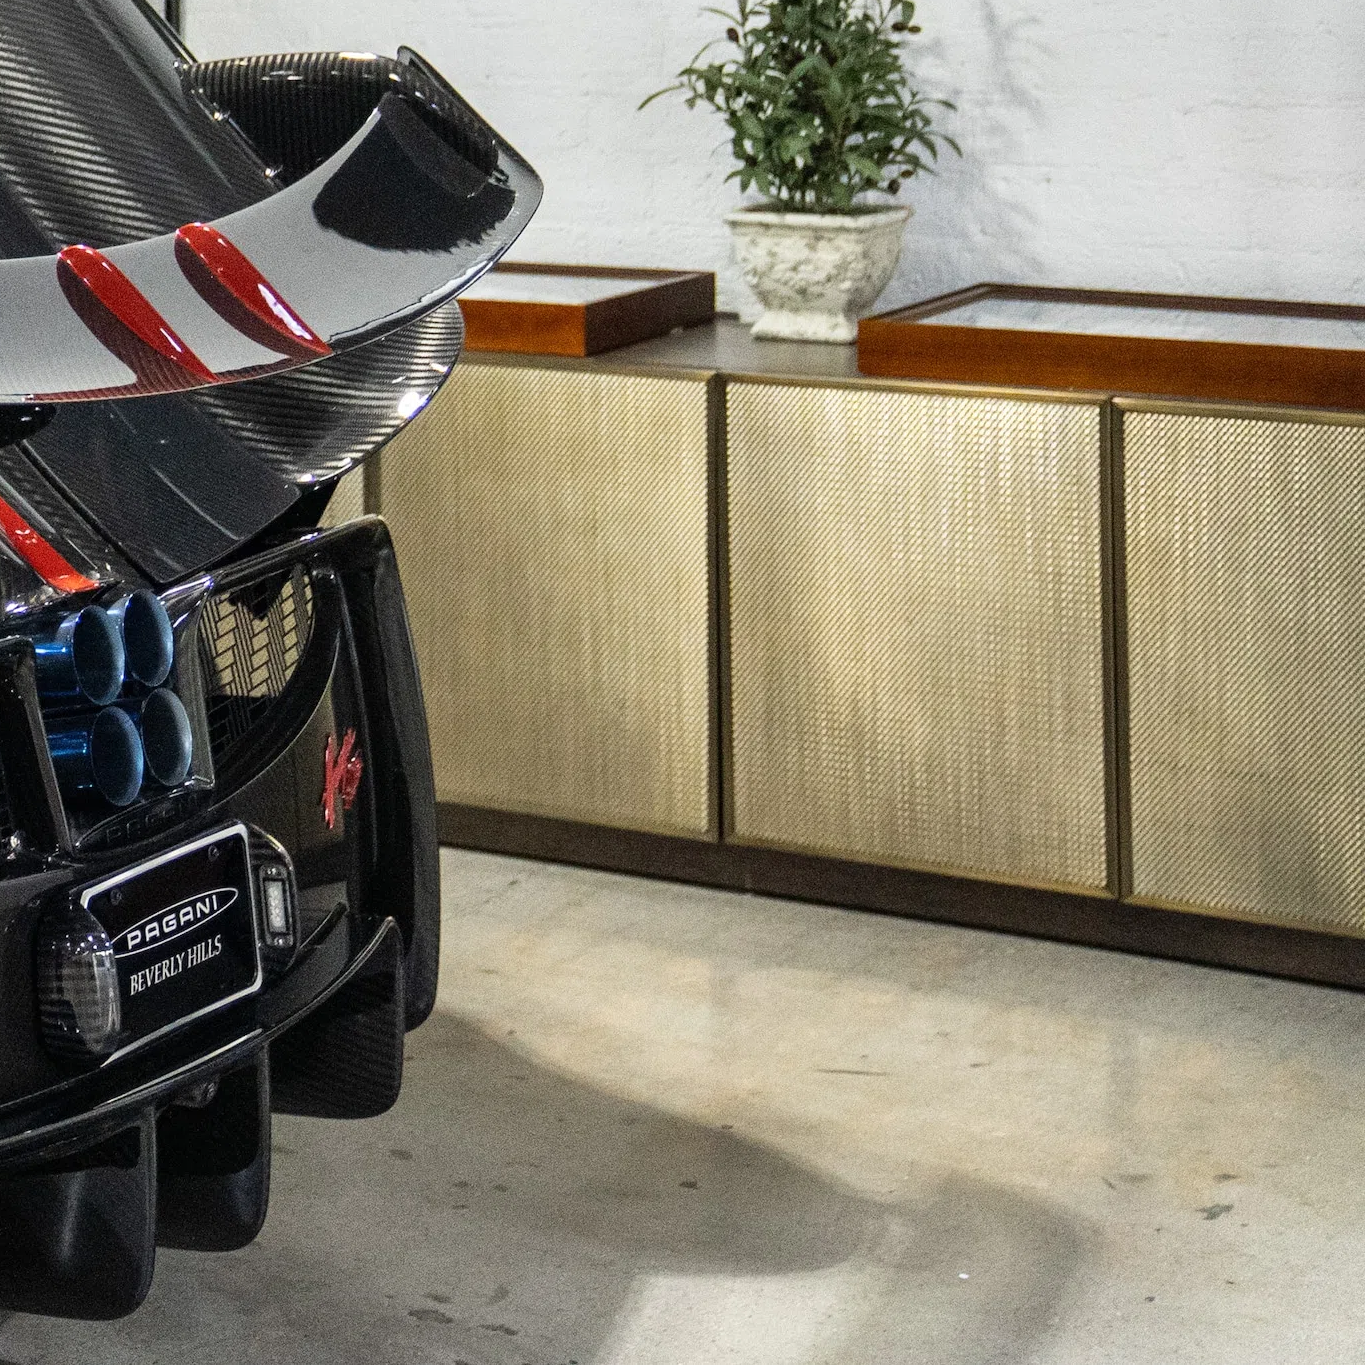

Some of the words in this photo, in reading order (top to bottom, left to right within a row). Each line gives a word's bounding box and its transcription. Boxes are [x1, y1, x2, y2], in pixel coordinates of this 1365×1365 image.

[127, 894, 218, 950] PAGANI
[130, 951, 186, 996] BEVERLY
[187, 934, 222, 969] HILLS
